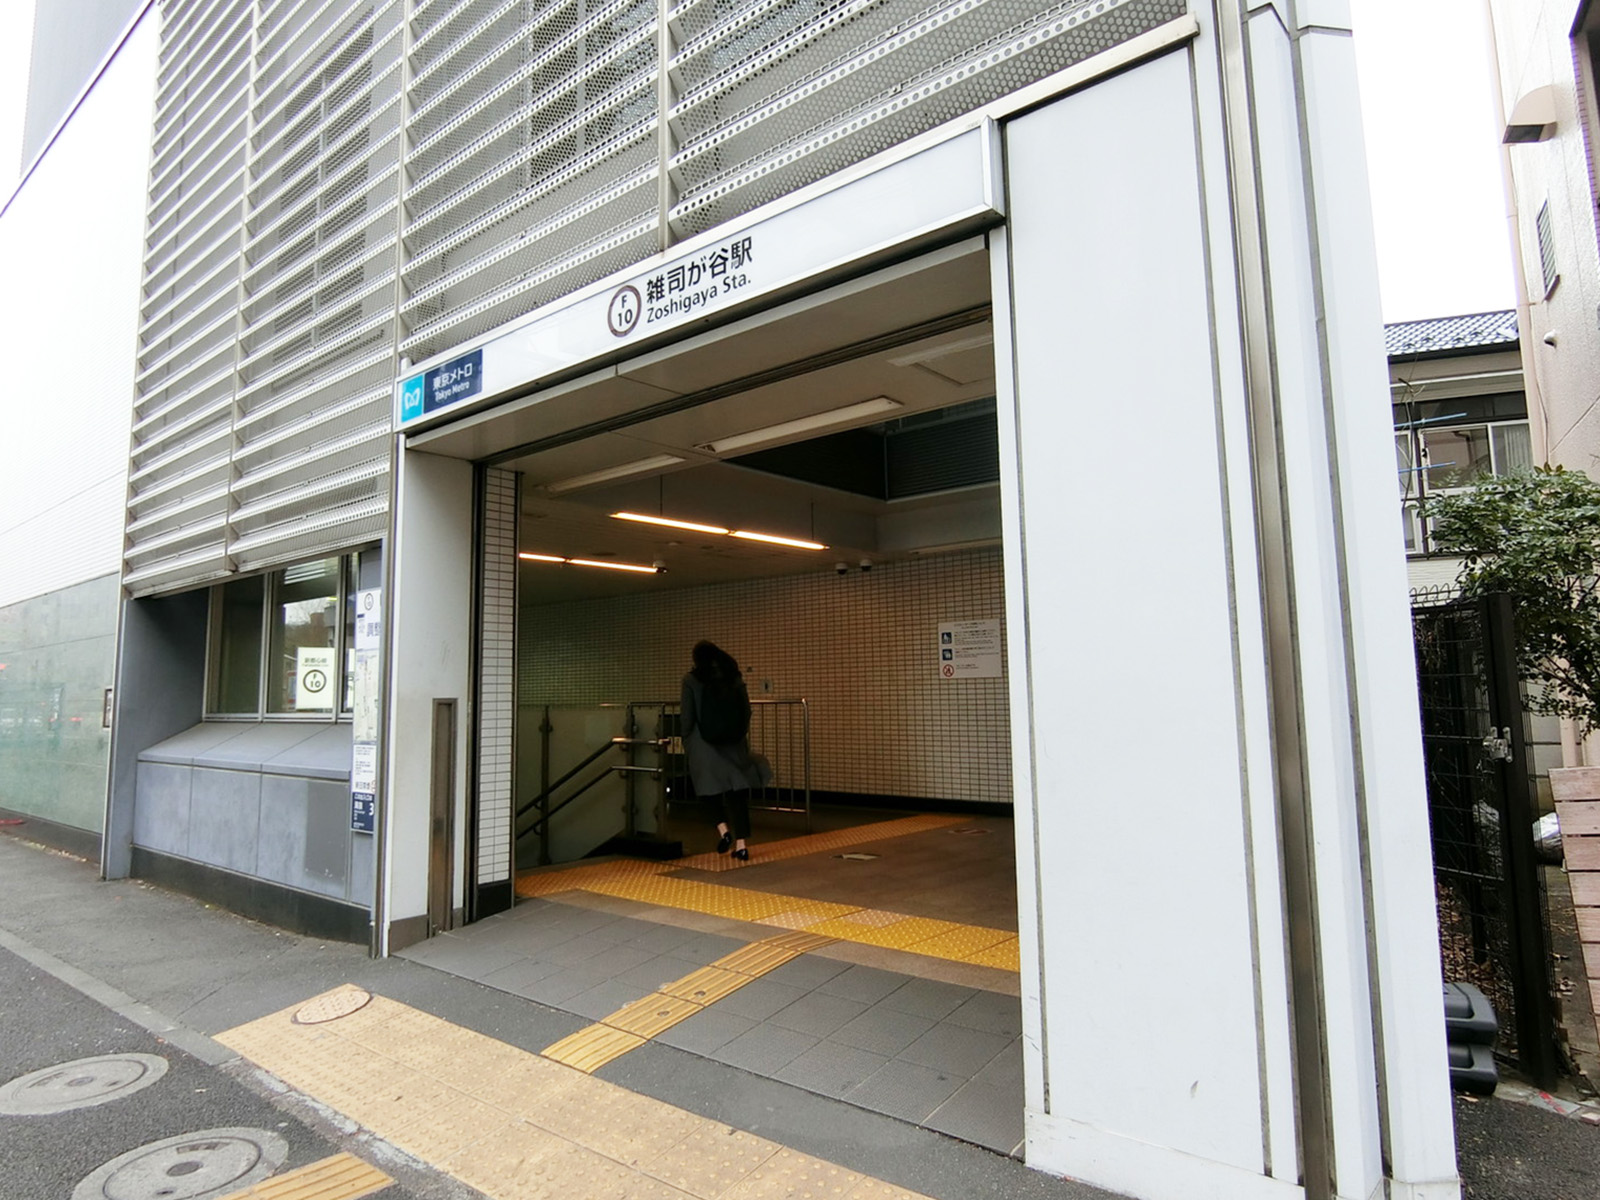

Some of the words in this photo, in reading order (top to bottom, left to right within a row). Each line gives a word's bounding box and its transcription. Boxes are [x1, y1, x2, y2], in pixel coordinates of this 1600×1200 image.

[646, 236, 753, 304] 雑司が谷駅
[621, 294, 628, 309] F
[646, 285, 718, 323] Zoshigaya
[723, 273, 752, 294] Sta.
[617, 308, 633, 327] 10
[432, 362, 473, 391] 東京メトロ
[434, 388, 452, 403] Tokyo
[452, 381, 470, 395] Metro
[310, 680, 321, 688] 10
